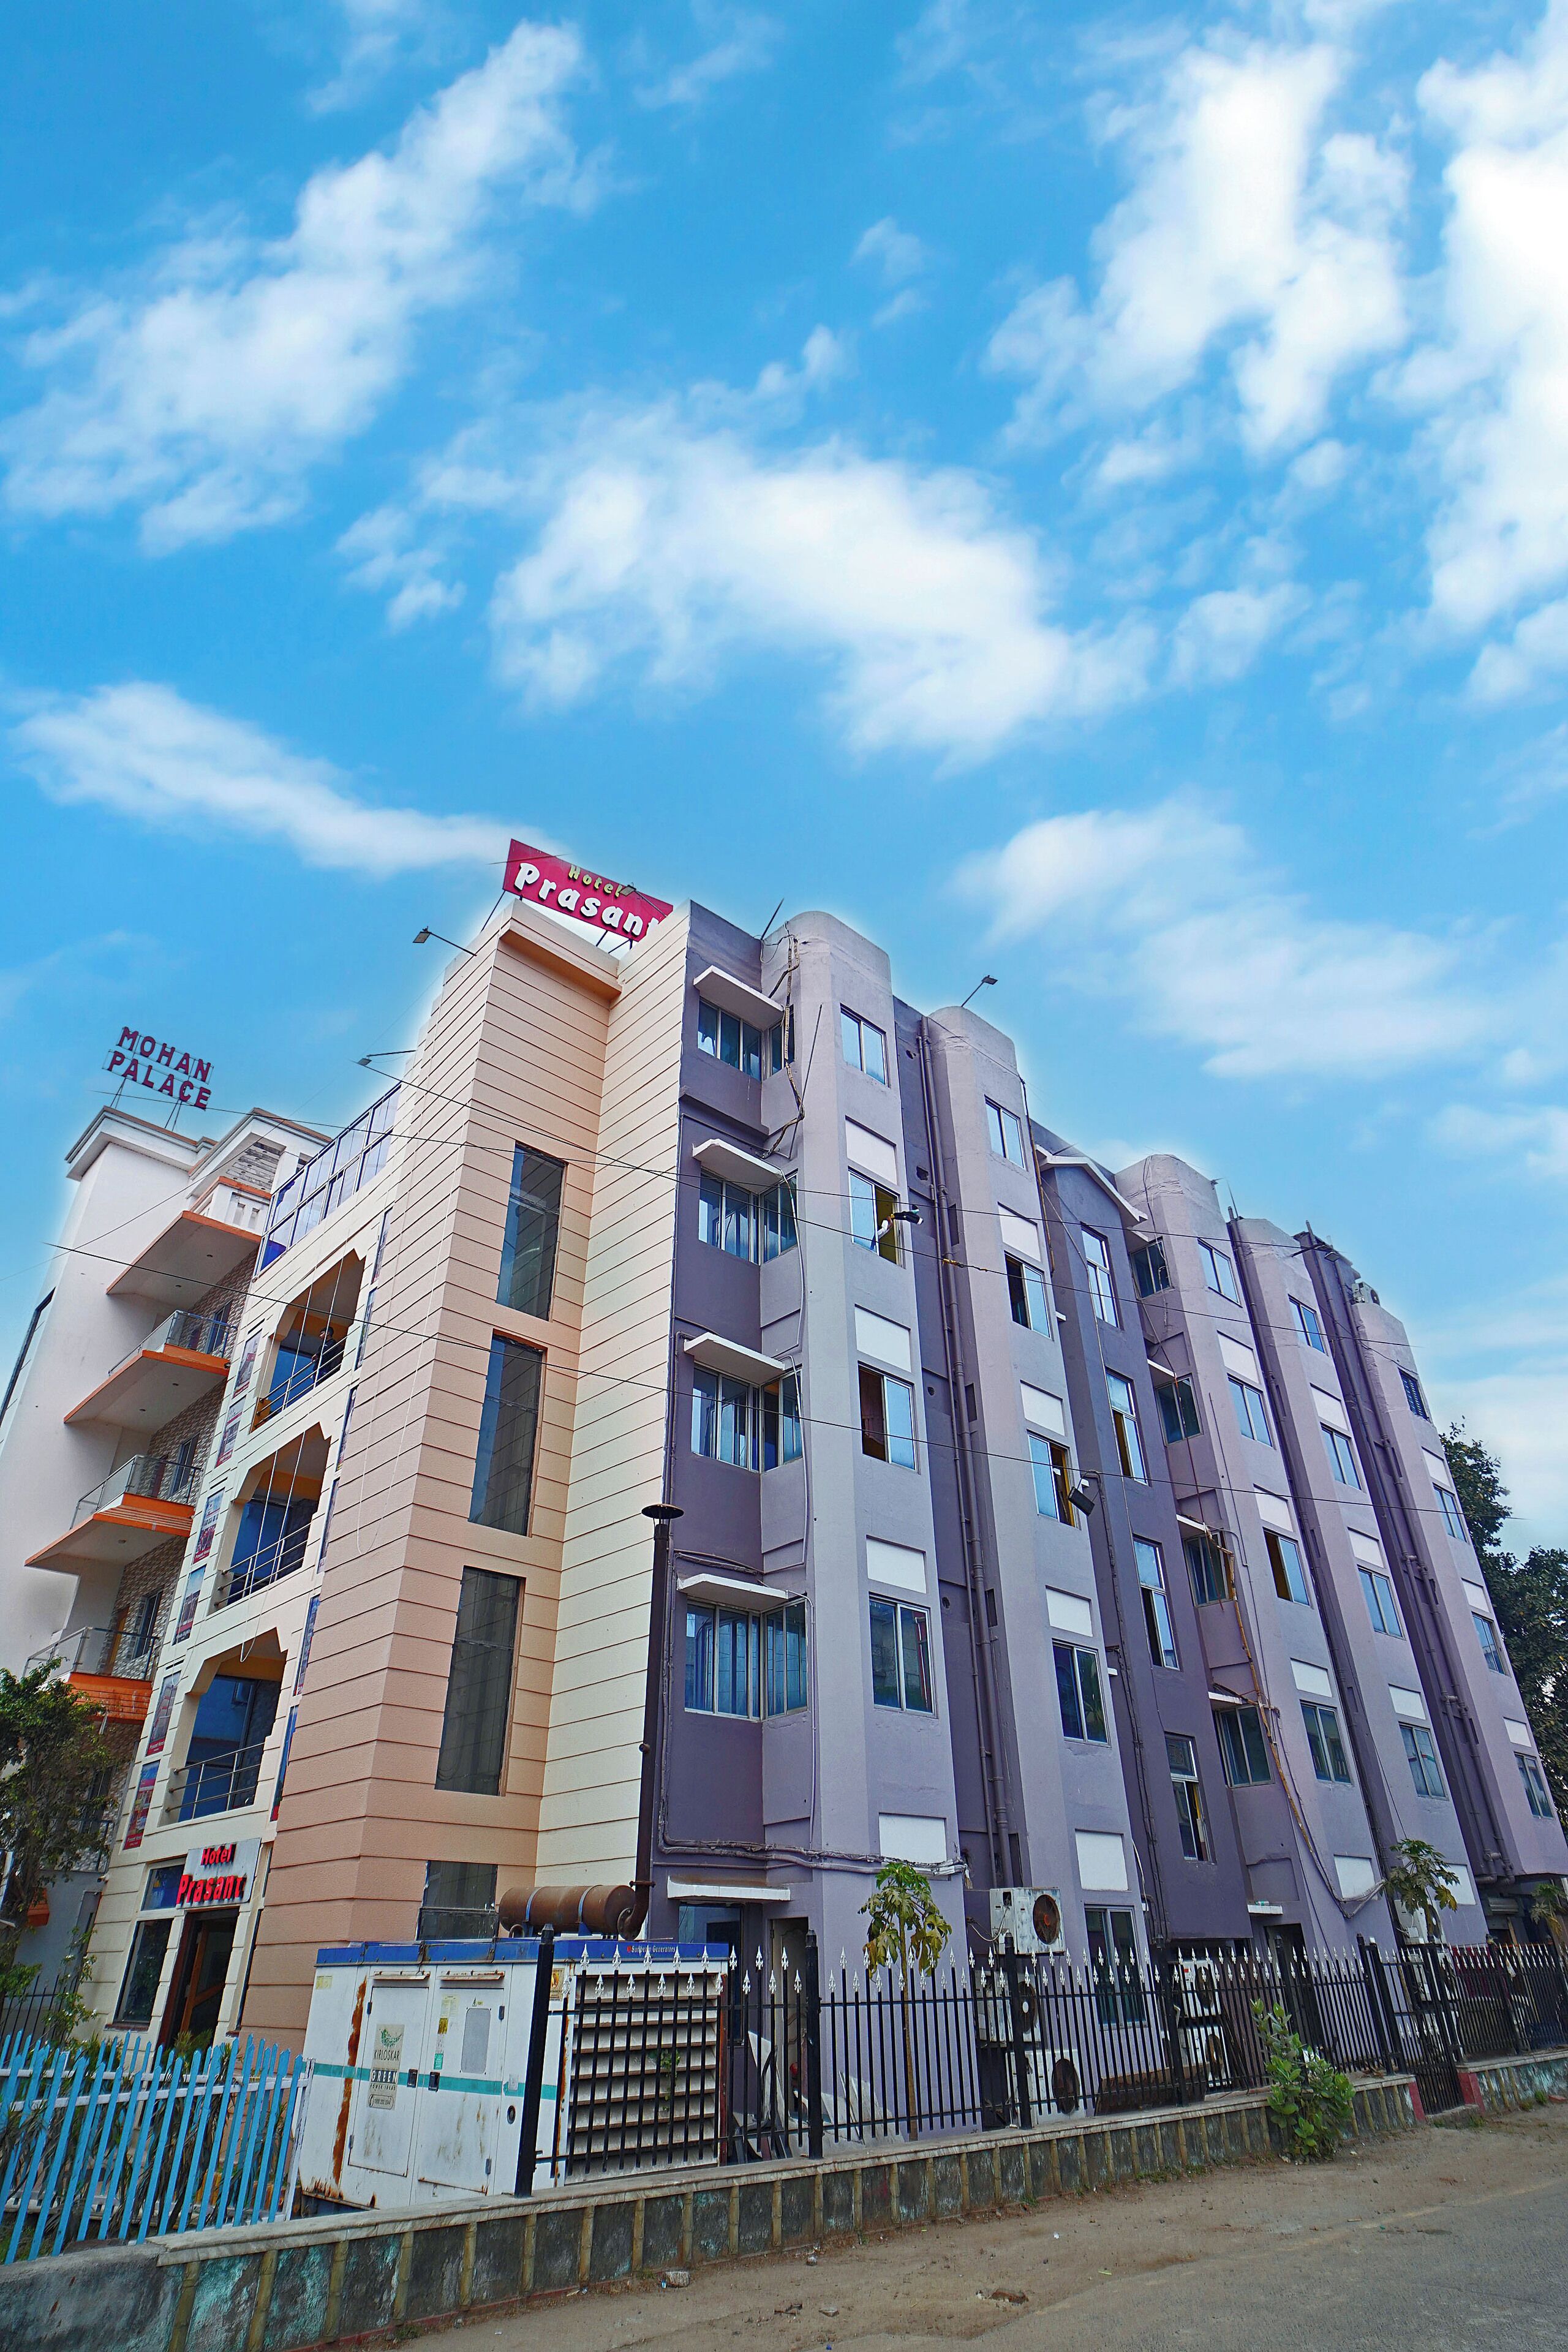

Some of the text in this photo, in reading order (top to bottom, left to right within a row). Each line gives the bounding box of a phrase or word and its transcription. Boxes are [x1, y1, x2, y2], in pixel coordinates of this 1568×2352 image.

[568, 865, 623, 897] Hotel
[117, 1027, 211, 1082] MOHAN
[108, 1050, 211, 1110] PALACE
[201, 1844, 236, 1866] Hotel
[374, 2049, 400, 2061] KIRLOSKAR
[371, 2070, 398, 2083] GREEN
